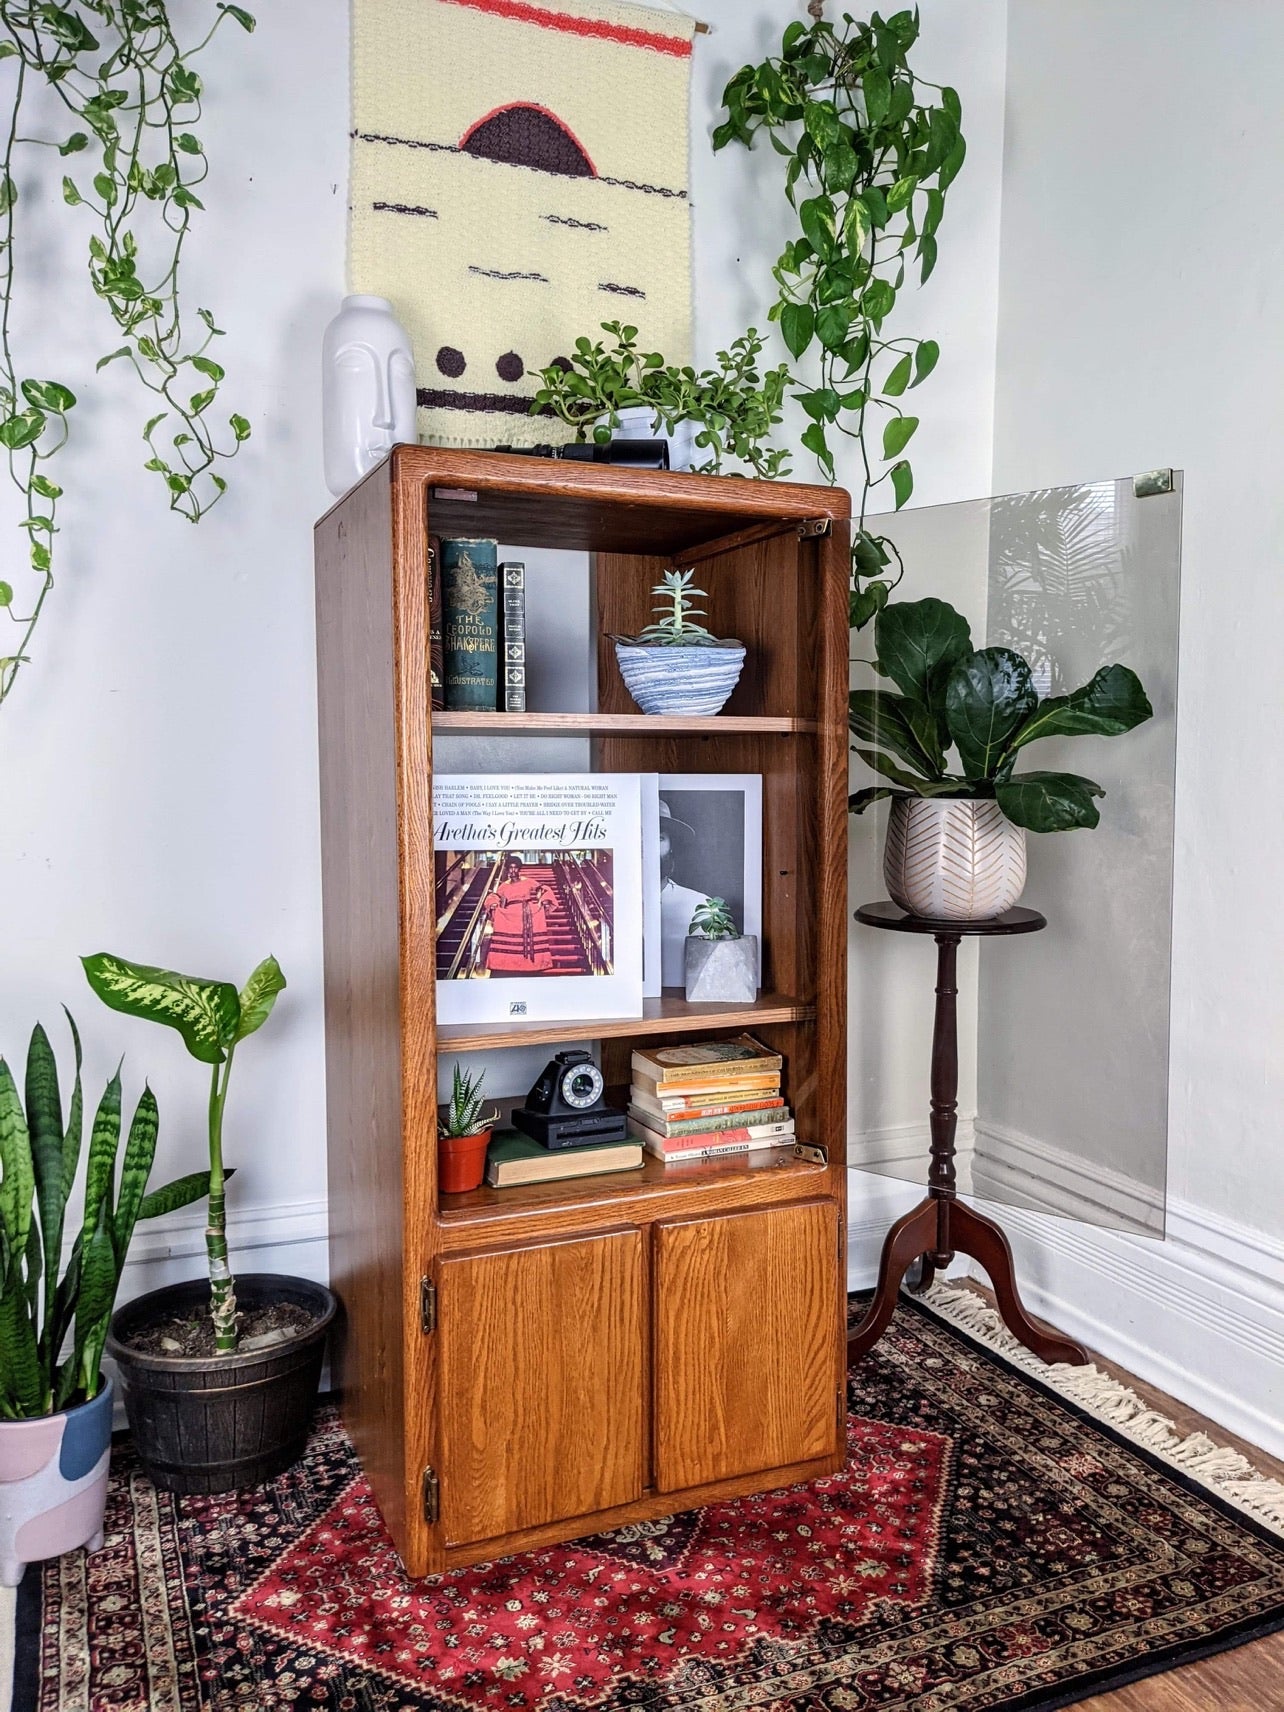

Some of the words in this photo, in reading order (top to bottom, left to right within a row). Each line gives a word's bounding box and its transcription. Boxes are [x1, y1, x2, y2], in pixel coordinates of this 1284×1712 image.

[456, 615, 484, 625] THE
[434, 821, 497, 841] Aretha's
[496, 820, 566, 848] Greatest
[559, 815, 607, 847] Hits
